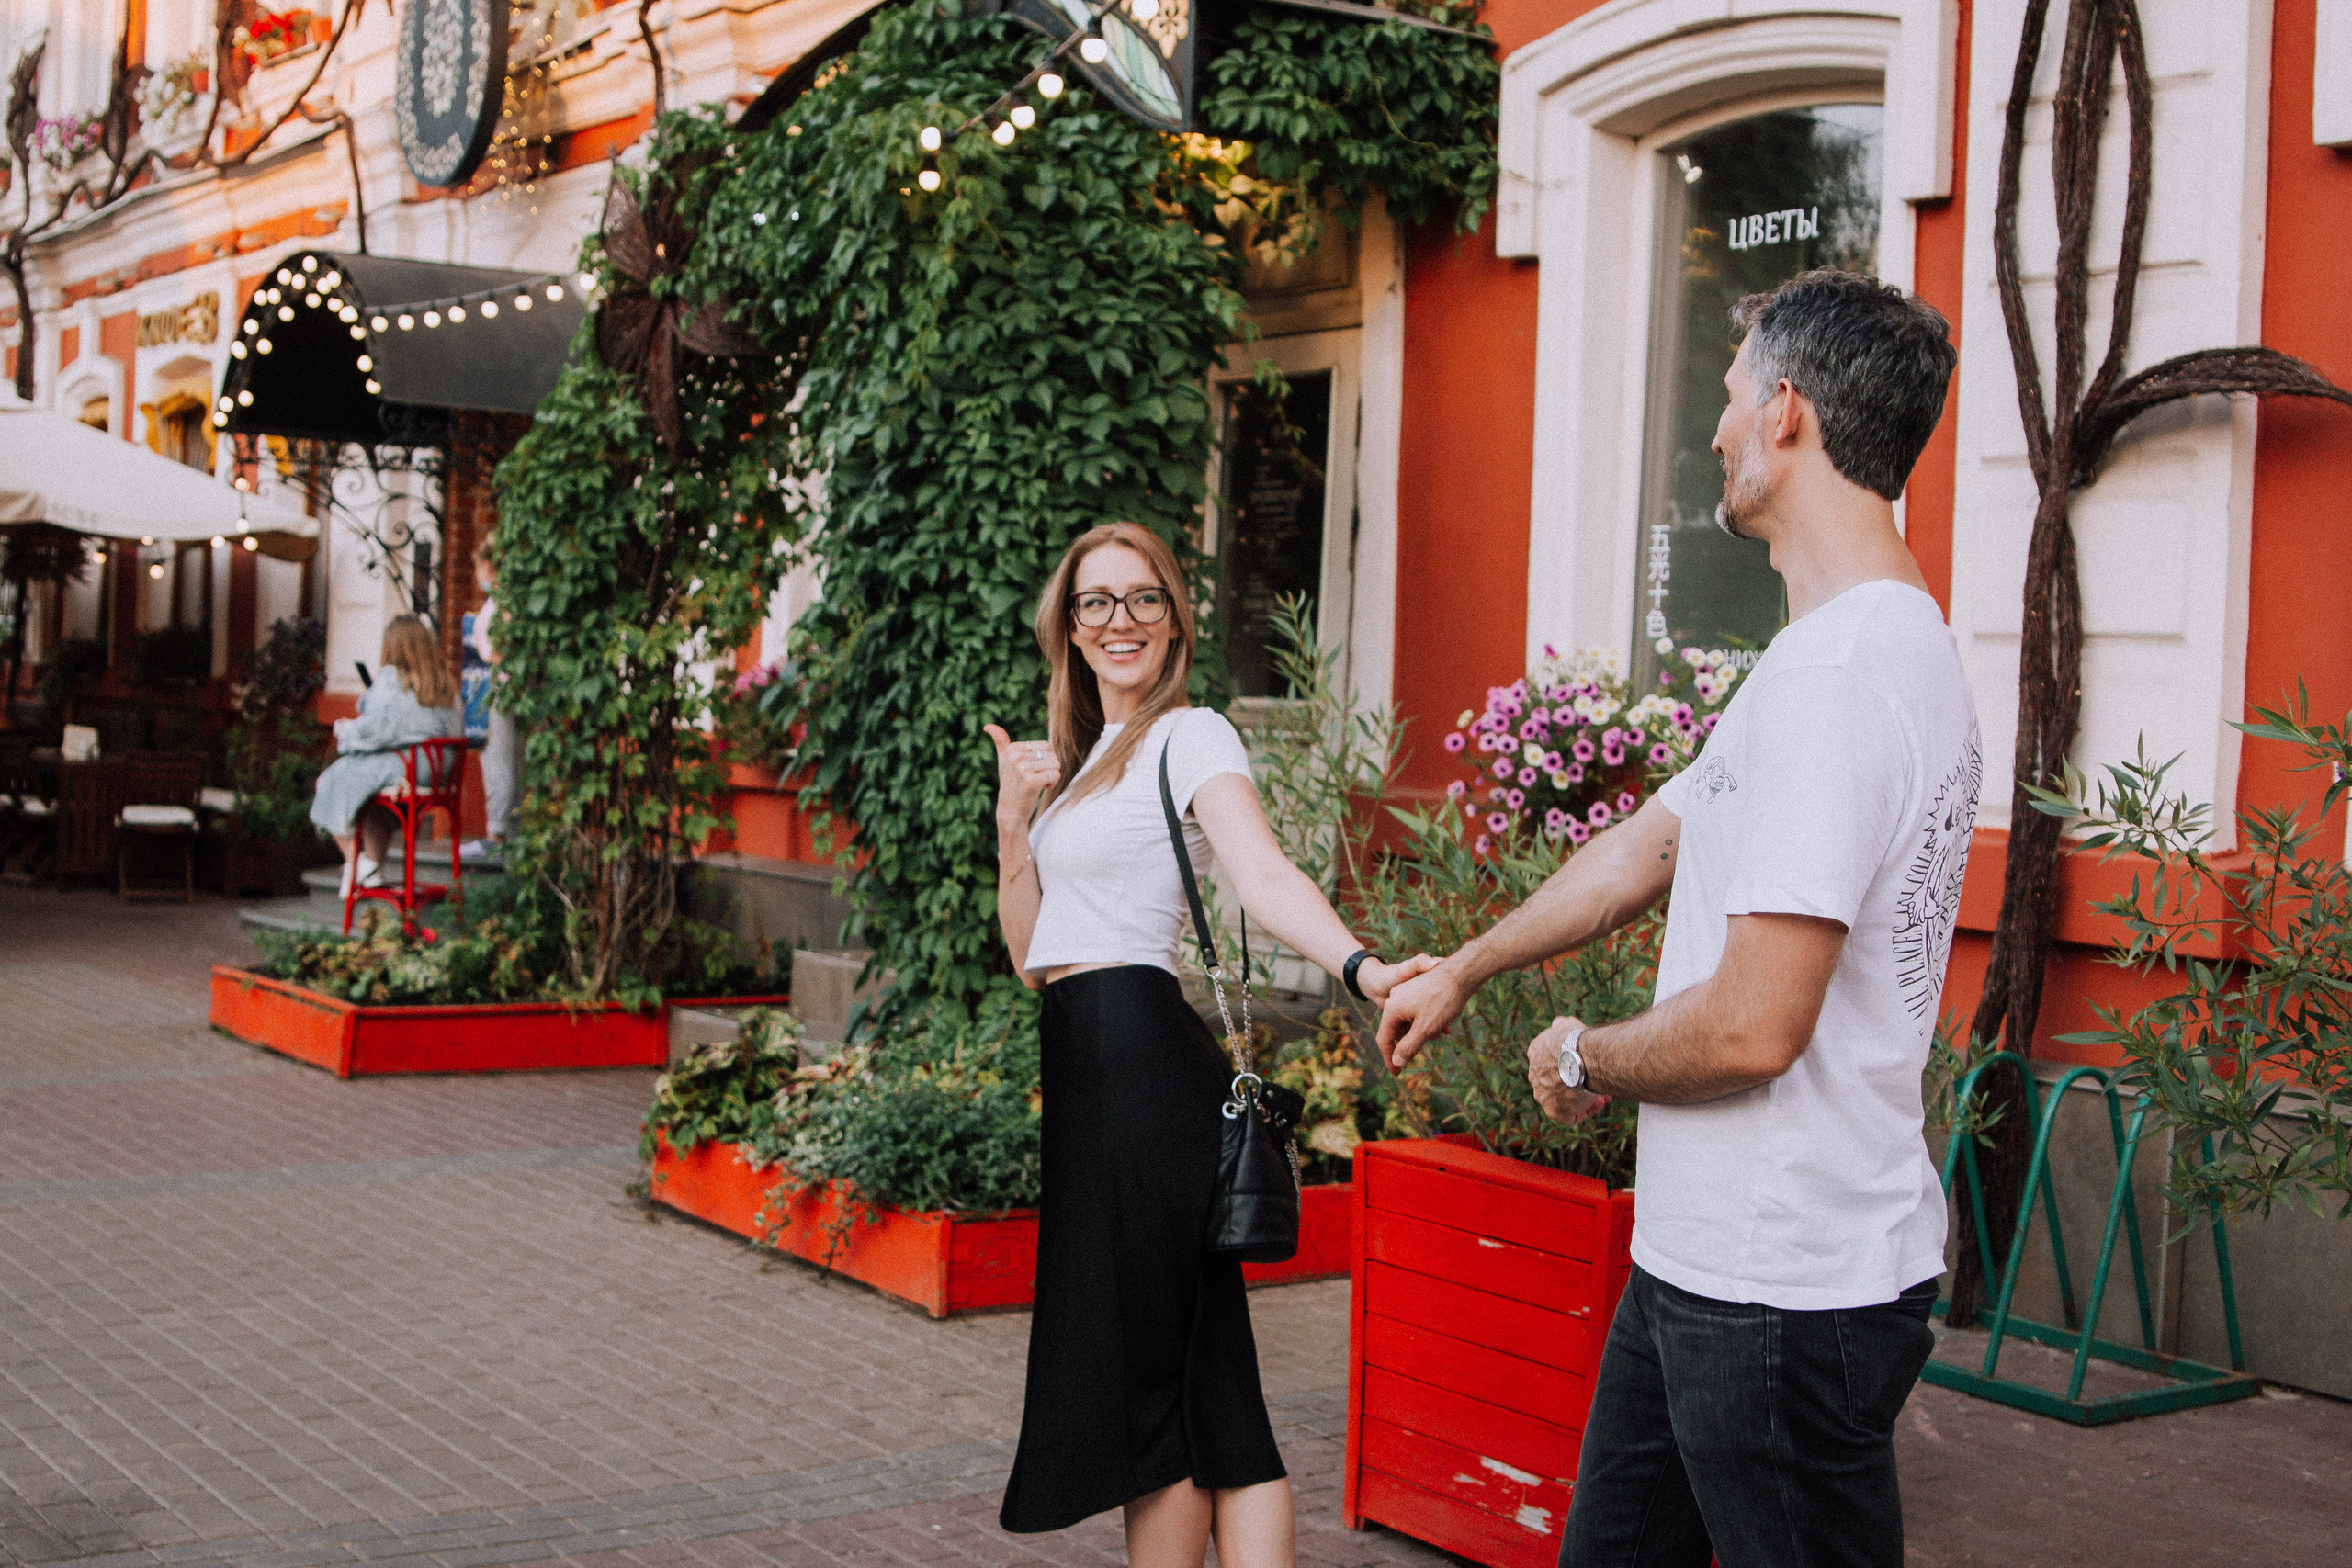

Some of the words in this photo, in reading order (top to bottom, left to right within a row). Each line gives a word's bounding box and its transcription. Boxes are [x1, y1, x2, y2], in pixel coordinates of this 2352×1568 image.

[1728, 205, 1819, 251] ЦВЕТЫ
[1645, 524, 1671, 639] 五光十色
[1892, 923, 1927, 988] PLACES
